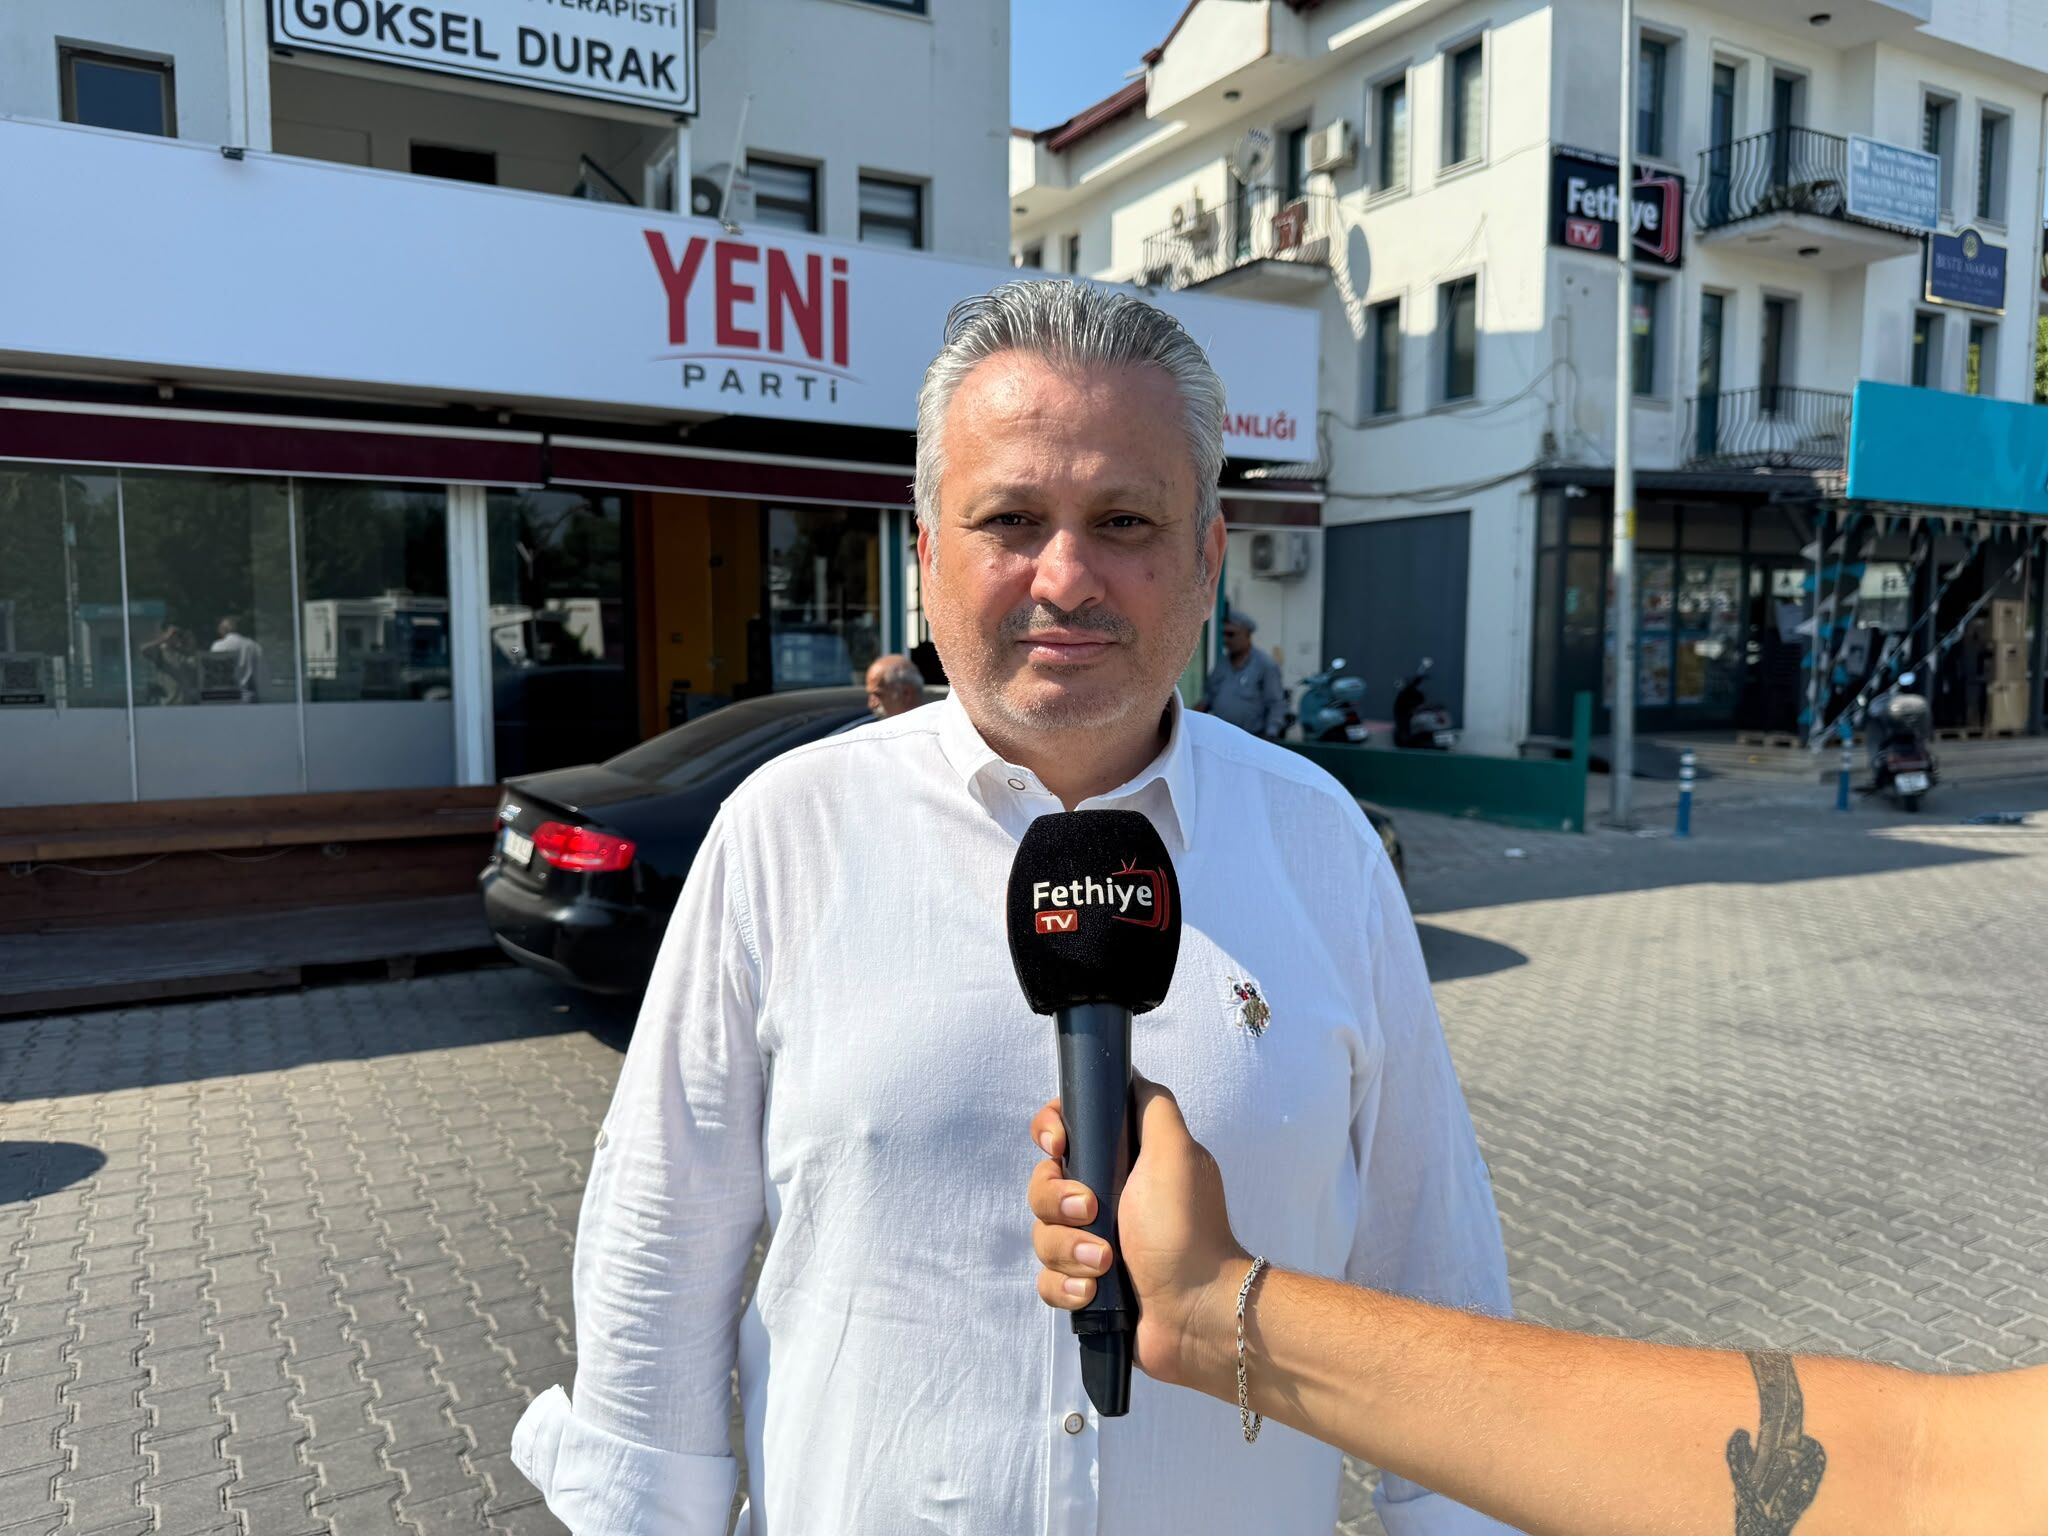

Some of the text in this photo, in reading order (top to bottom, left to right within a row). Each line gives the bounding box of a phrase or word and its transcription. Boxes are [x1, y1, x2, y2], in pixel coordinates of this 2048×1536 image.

[518, 26, 677, 92] DURAK
[1567, 177, 1659, 235] Fethye
[1571, 224, 1599, 245] TV
[1222, 410, 1297, 441] ANLIĞI
[1033, 876, 1153, 913] Fethiye
[1042, 914, 1073, 930] TV
